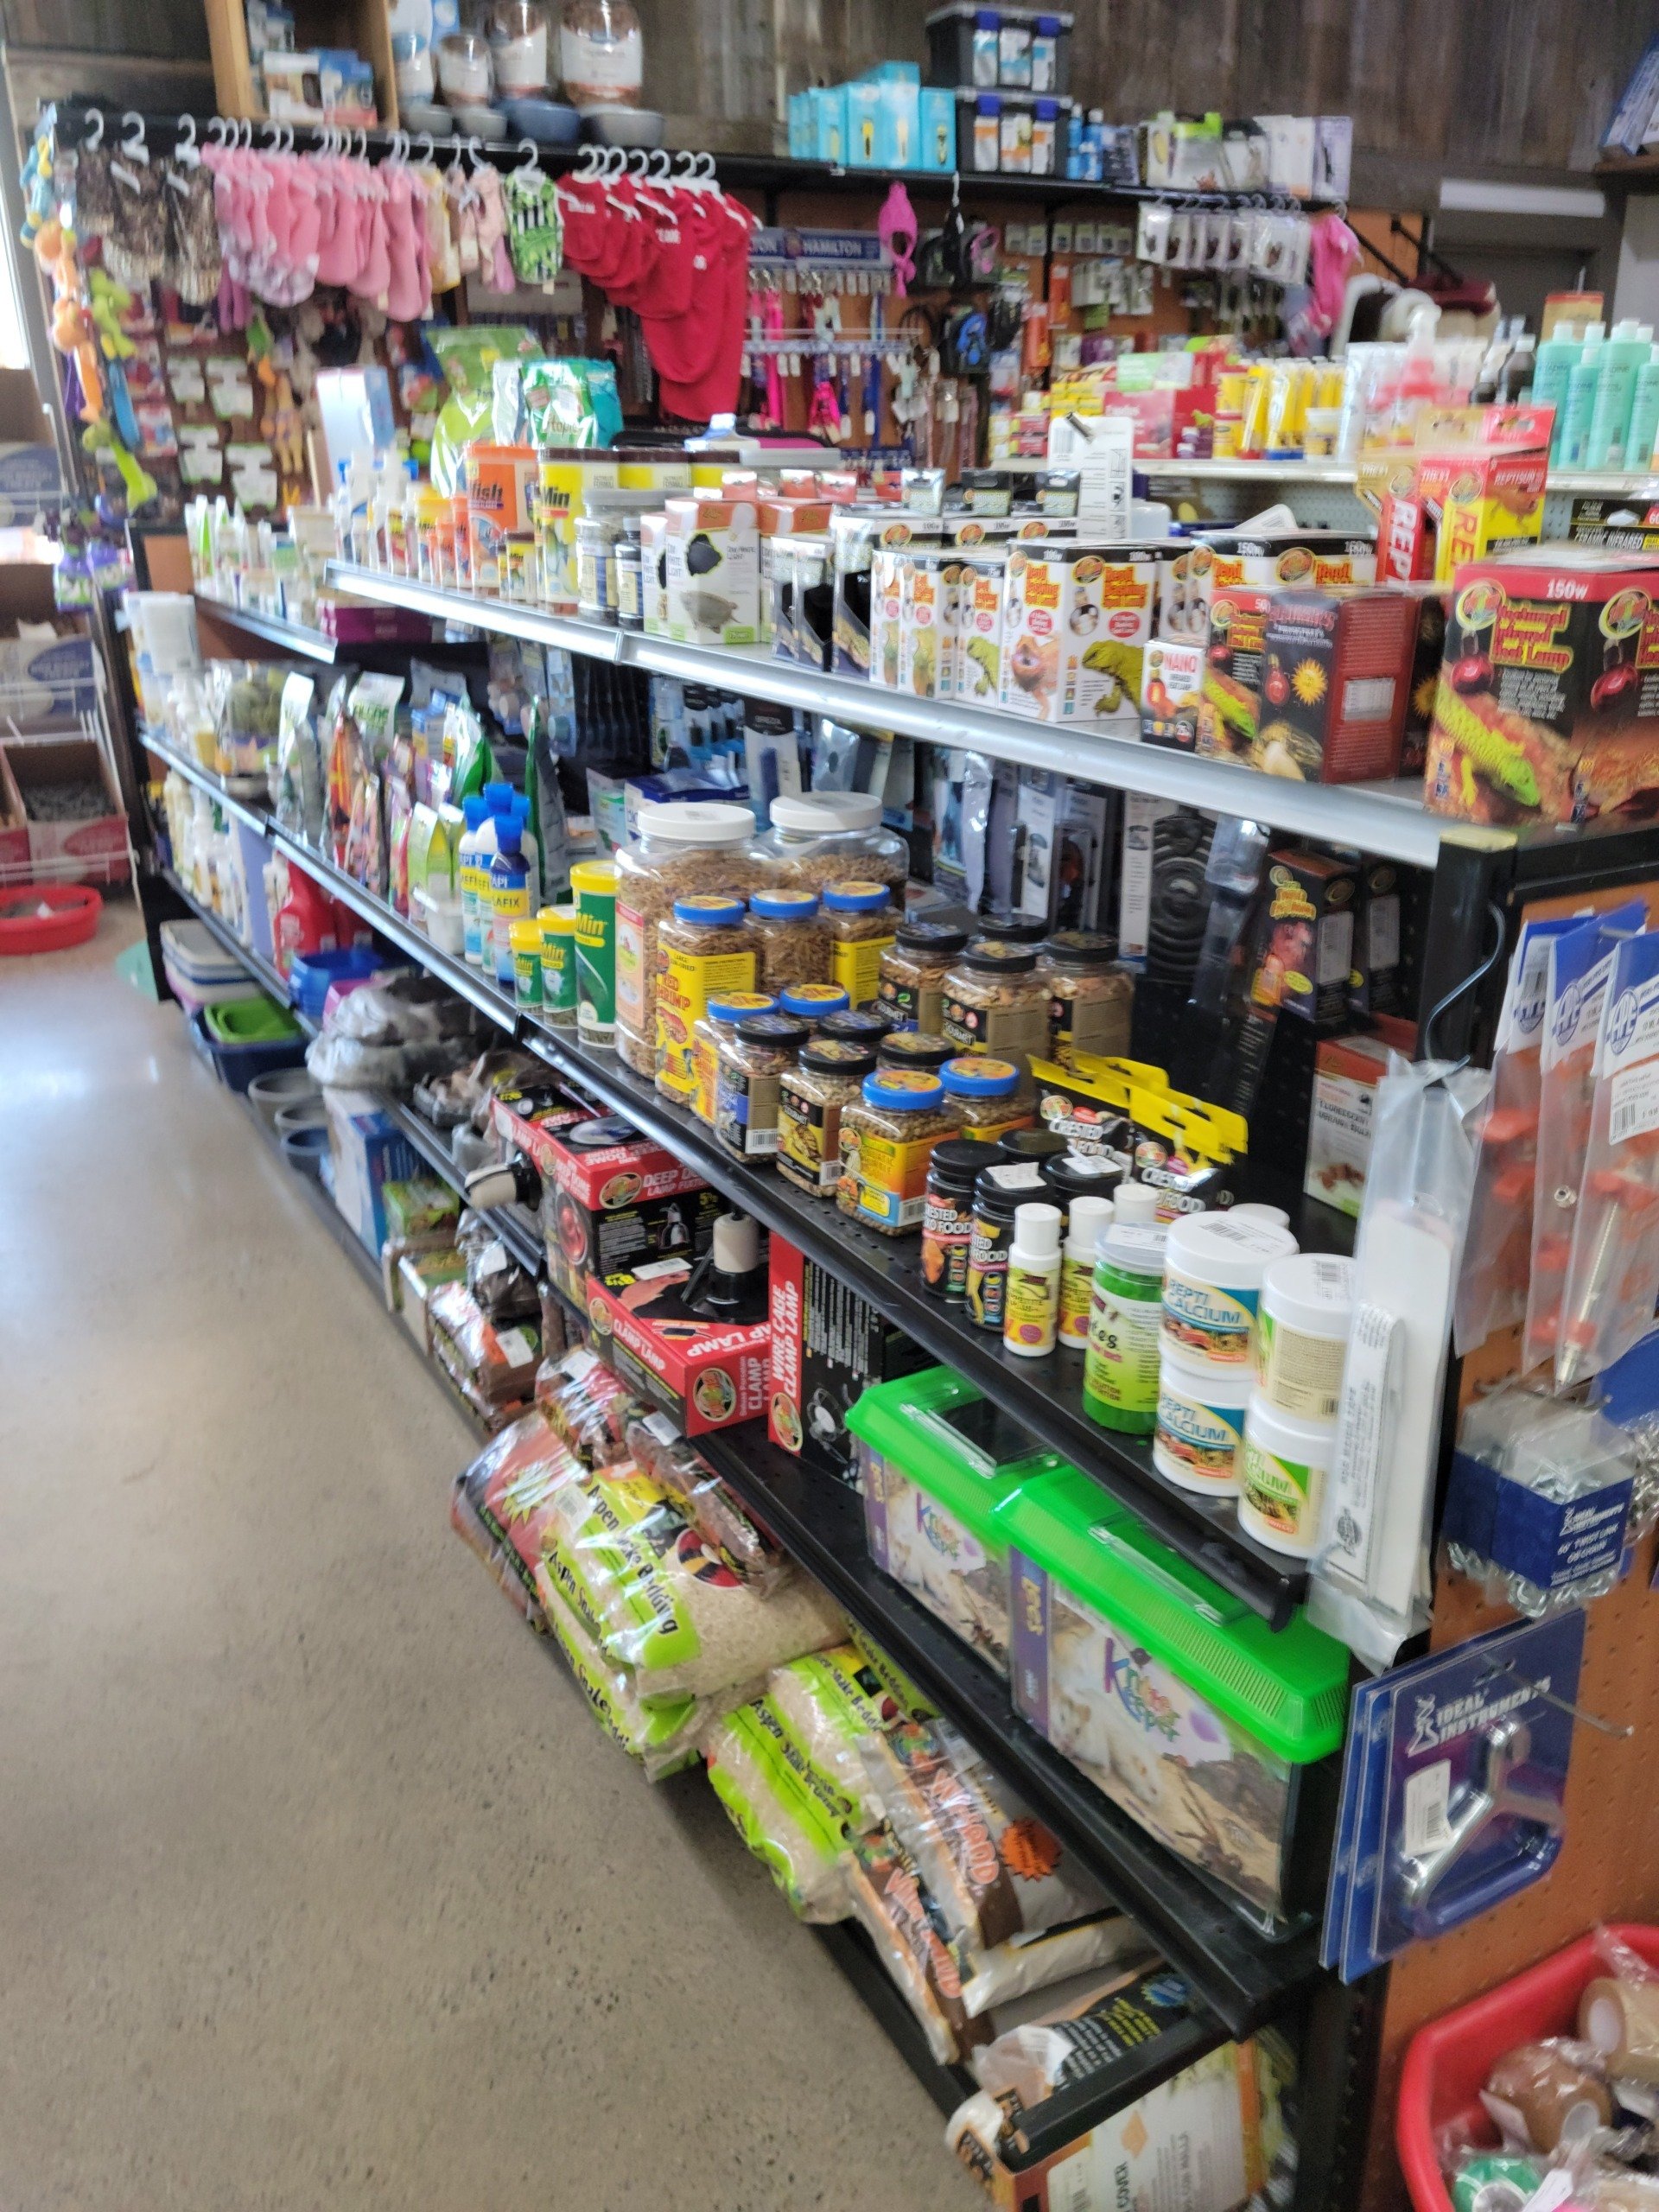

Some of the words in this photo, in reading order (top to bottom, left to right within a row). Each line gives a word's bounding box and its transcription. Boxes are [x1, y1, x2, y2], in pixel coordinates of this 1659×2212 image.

[804, 238, 863, 255] HAMILTON
[1606, 527, 1644, 550] INFRARED
[1547, 580, 1588, 600] 150w
[1165, 652, 1198, 674] NANO
[492, 874, 508, 888] API
[1049, 1119, 1103, 1140] CRESTED
[643, 1170, 679, 1189] DEEP
[938, 1222, 973, 1234] FOOD
[1168, 1277, 1210, 1306] REPTI
[772, 1284, 786, 1332] CAGE
[785, 1280, 798, 1336] LAMP
[1169, 1293, 1243, 1324] CALCIUM
[686, 1331, 747, 1357] LAMP
[773, 1333, 785, 1382] WIRE
[783, 1336, 798, 1399] CLAMP
[747, 1357, 763, 1410] CLAMP
[1160, 1408, 1227, 1442] CALCIUM
[749, 1698, 785, 1738] Aspen
[1437, 1688, 1490, 1726] IDEAL
